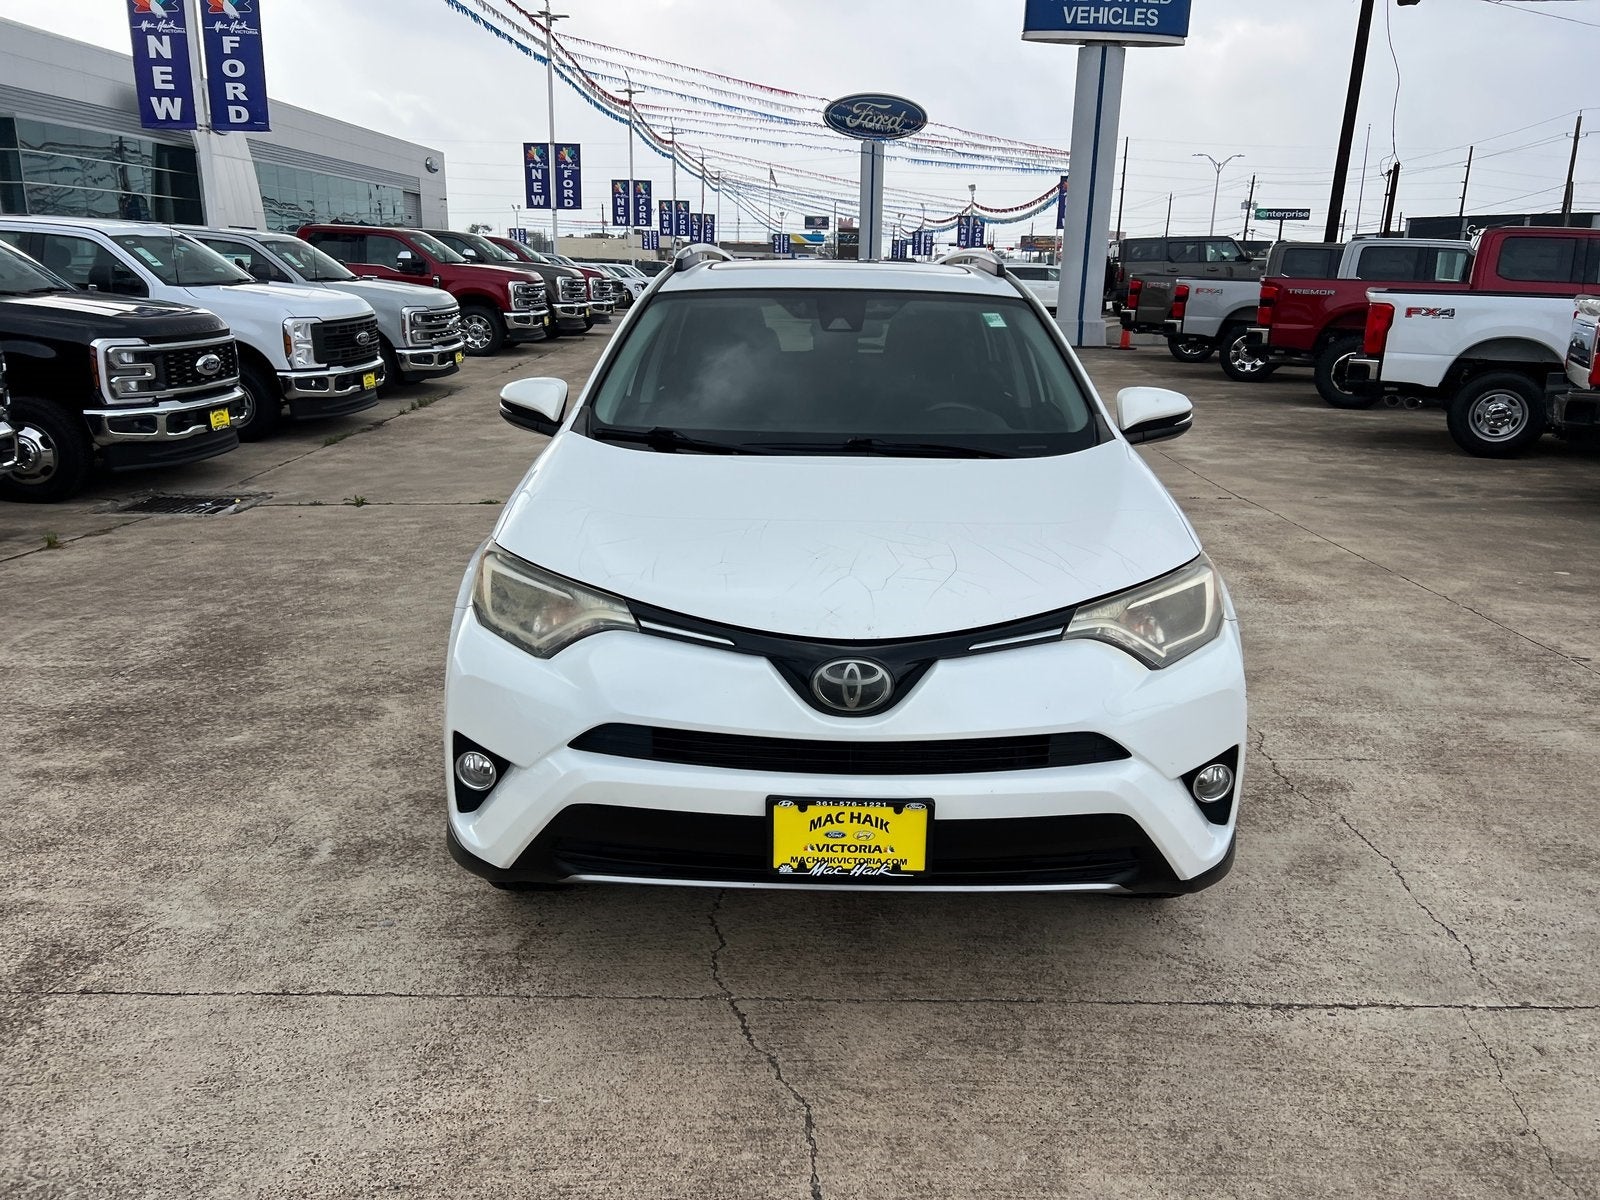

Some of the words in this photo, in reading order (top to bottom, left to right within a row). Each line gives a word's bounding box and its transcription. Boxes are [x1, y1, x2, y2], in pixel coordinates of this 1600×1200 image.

[1063, 6, 1159, 27] VEHICLES
[147, 35, 182, 120] NEW
[222, 36, 249, 123] FORD
[845, 101, 906, 130] Ford
[531, 169, 545, 206] NEW
[562, 170, 574, 207] FORD
[616, 198, 626, 224] NEW
[638, 198, 647, 225] FORD
[1256, 210, 1309, 219] enterprise
[662, 214, 670, 234] NEW
[1287, 288, 1336, 296] TREMOR
[1405, 306, 1456, 318] FX4
[809, 811, 846, 832] MAC
[849, 811, 890, 834] HAIK
[816, 843, 883, 854] VICTORIA
[790, 856, 908, 866] MACHAIKVICTORIA.COM
[809, 861, 848, 877] Mac
[849, 863, 896, 877] Haik
